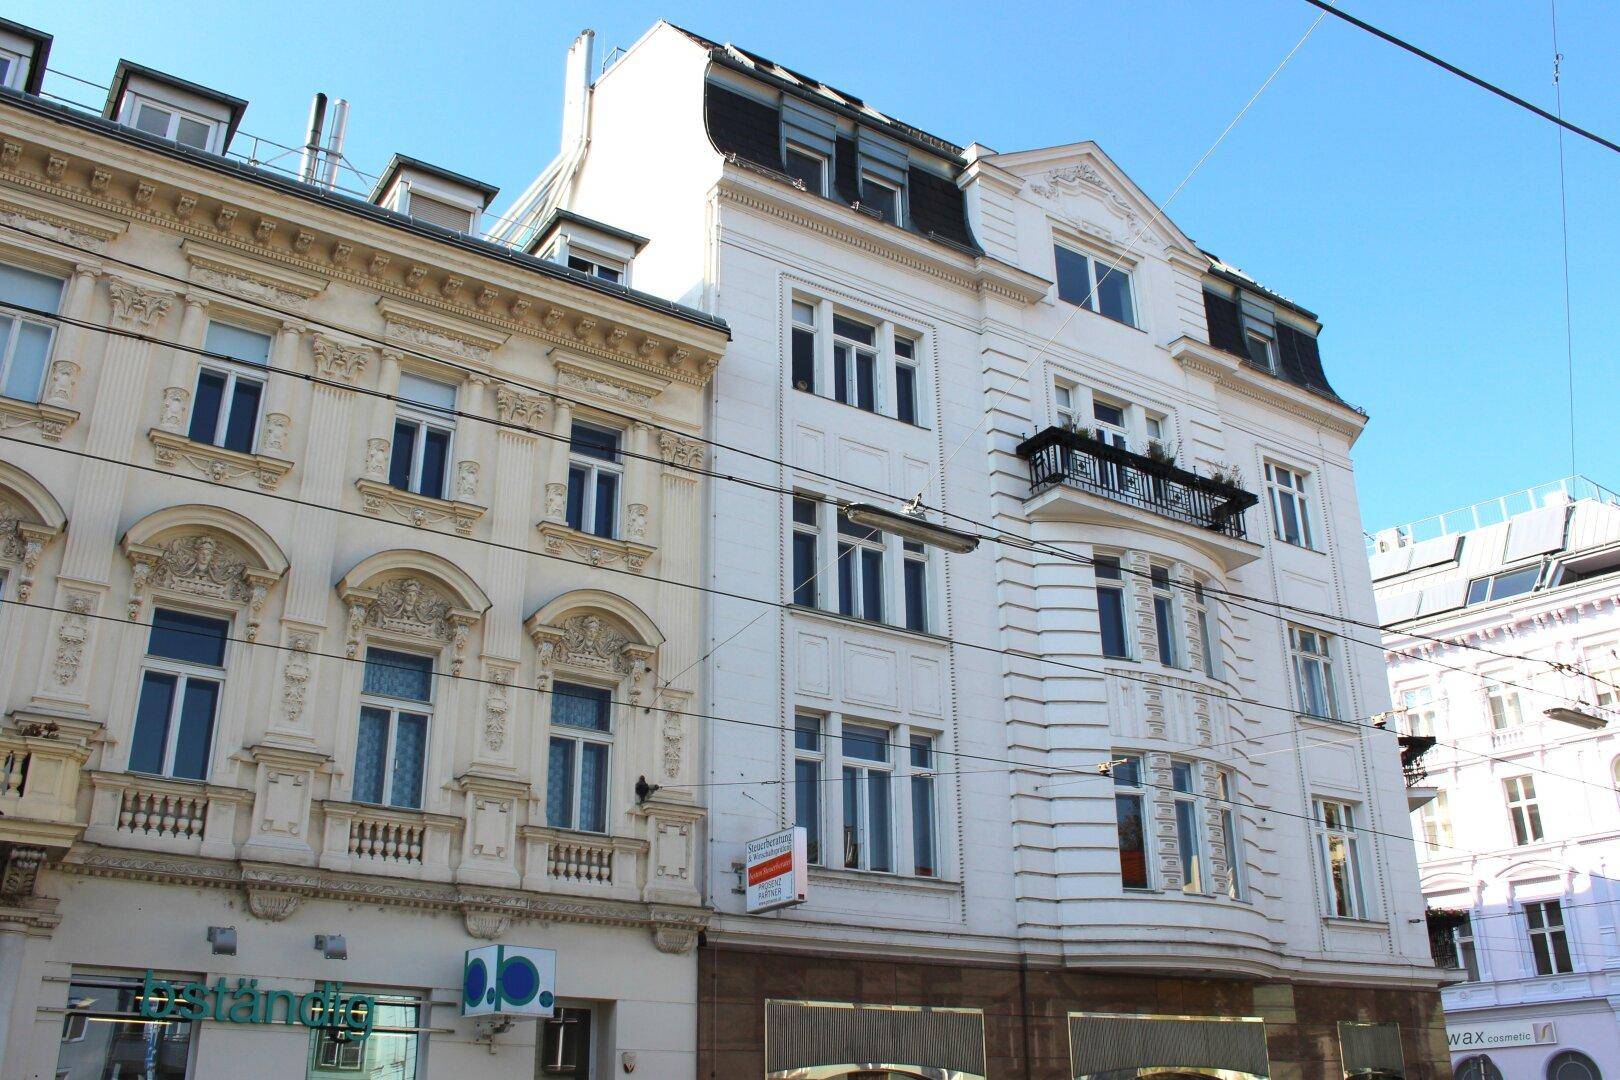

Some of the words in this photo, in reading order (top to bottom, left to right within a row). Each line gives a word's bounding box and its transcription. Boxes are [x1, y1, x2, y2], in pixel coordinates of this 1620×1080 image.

[748, 833, 792, 854] Steuerberatung
[758, 887, 782, 900] PARTNER
[140, 969, 375, 1041] bständig
[1448, 1031, 1485, 1046] wax
[1487, 1032, 1531, 1043] cosmetic
